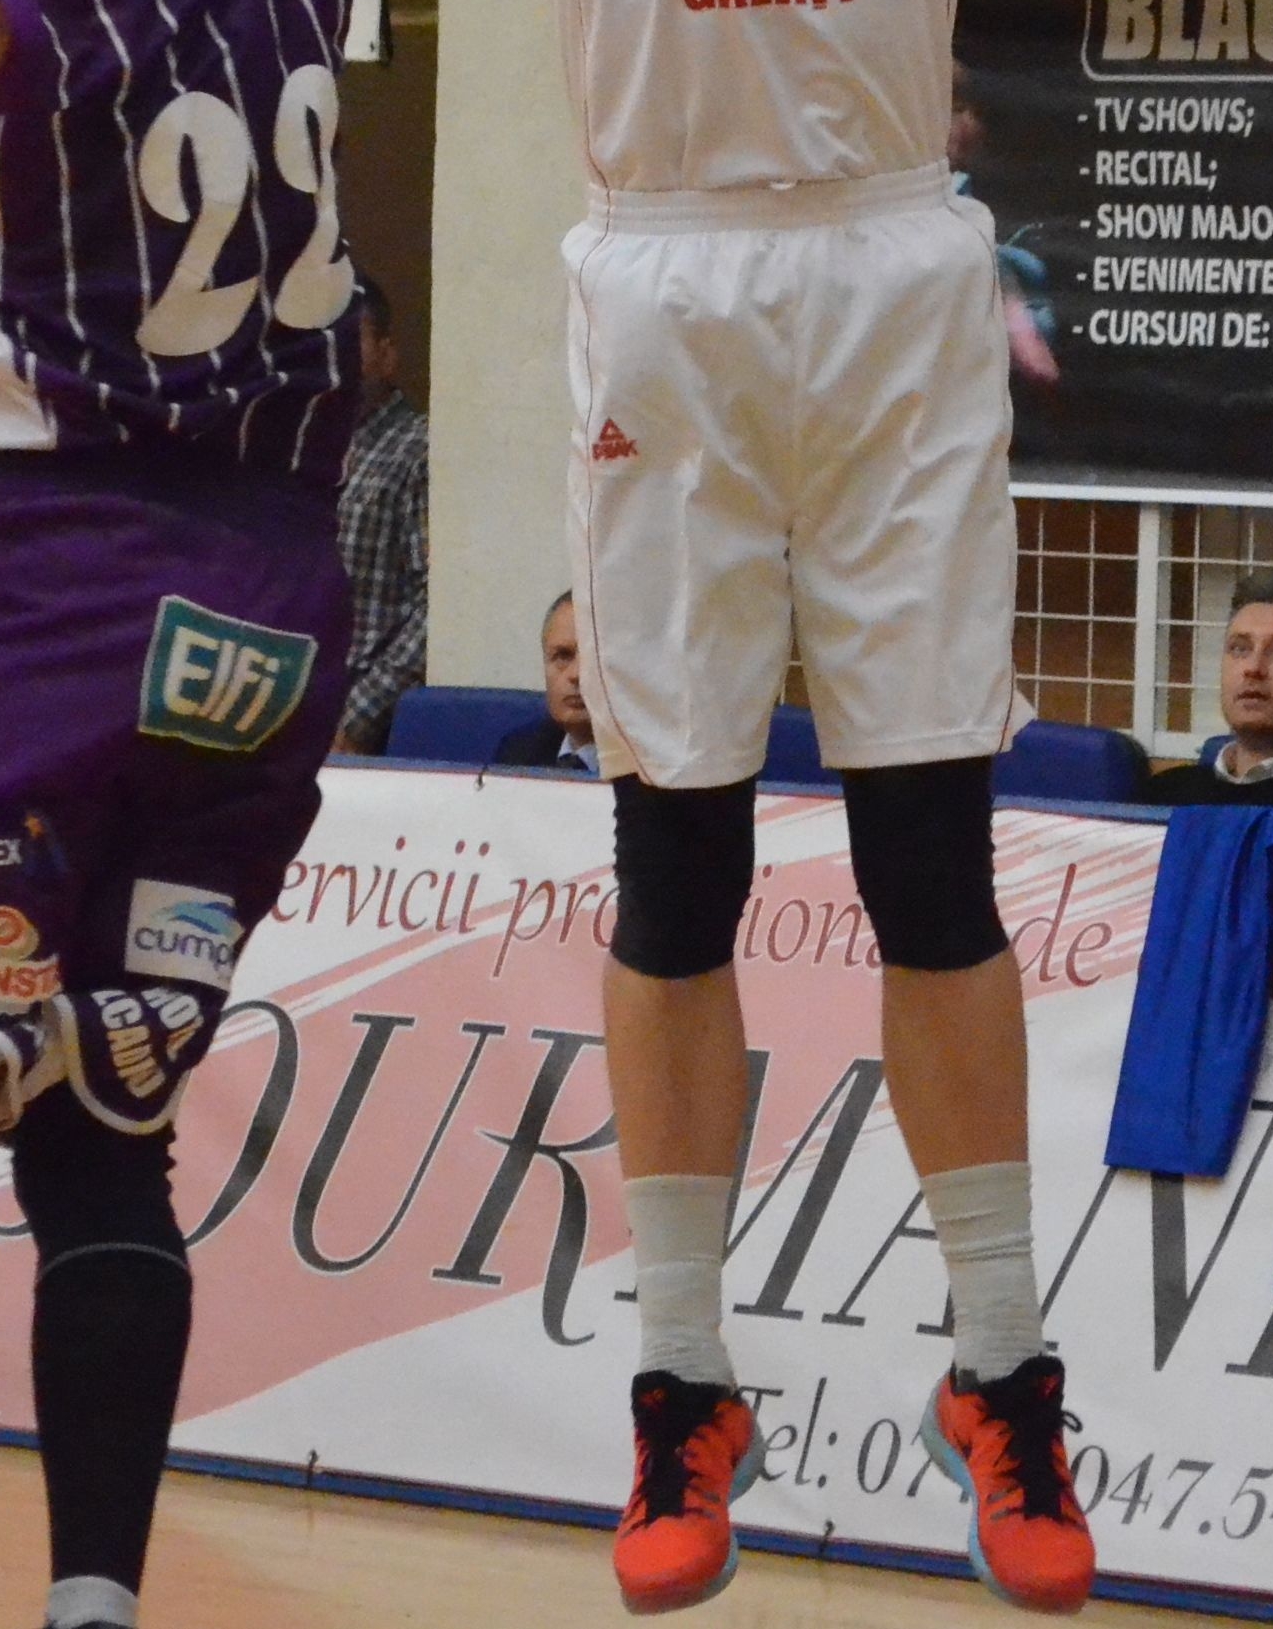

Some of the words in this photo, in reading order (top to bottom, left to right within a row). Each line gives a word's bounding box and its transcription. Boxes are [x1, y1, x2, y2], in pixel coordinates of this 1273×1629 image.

[1094, 97, 1132, 133] TV
[1137, 97, 1256, 139] SHOWS;
[1095, 150, 1219, 192] RECITAL;
[136, 63, 356, 357] 22
[1096, 204, 1183, 240] SHOW
[1088, 309, 1216, 348] CURSURI
[1222, 311, 1271, 349] DE:
[162, 623, 281, 733] Elfi
[269, 835, 493, 935] ervicii
[1013, 862, 1114, 987] de
